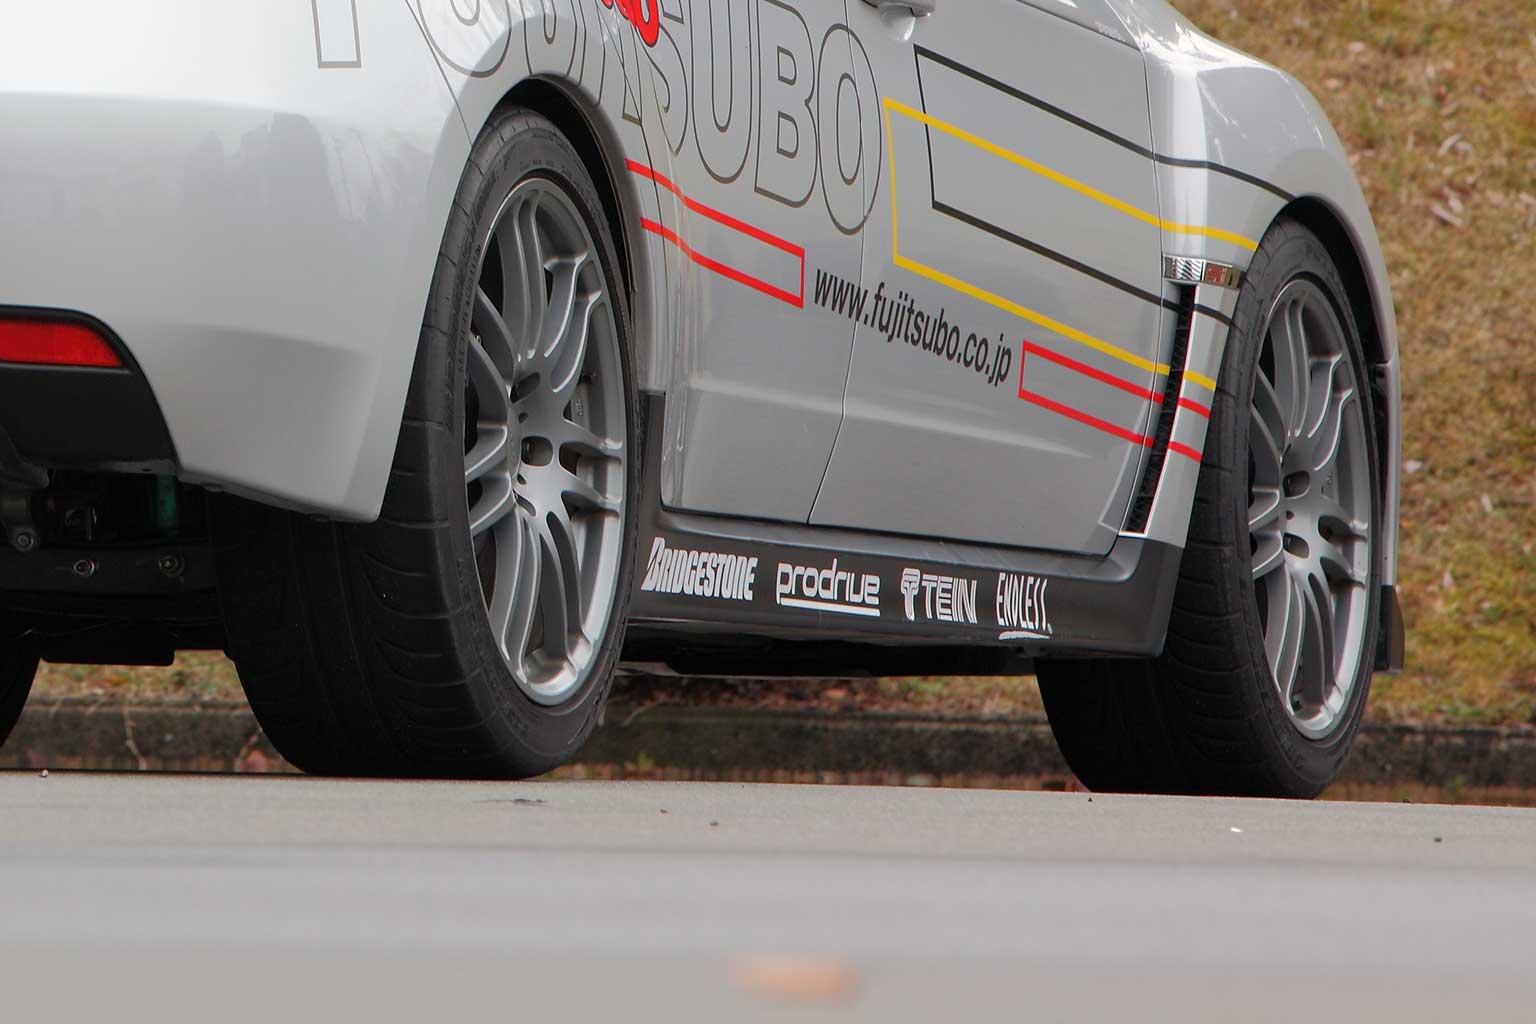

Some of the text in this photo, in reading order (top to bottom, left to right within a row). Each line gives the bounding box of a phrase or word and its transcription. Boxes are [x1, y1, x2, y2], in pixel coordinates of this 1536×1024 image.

[814, 269, 1012, 387] www.fujitsubo.co.jp
[641, 536, 758, 601] BRIDGESTONE
[776, 558, 880, 605] prodrive
[922, 573, 978, 624] TEIN
